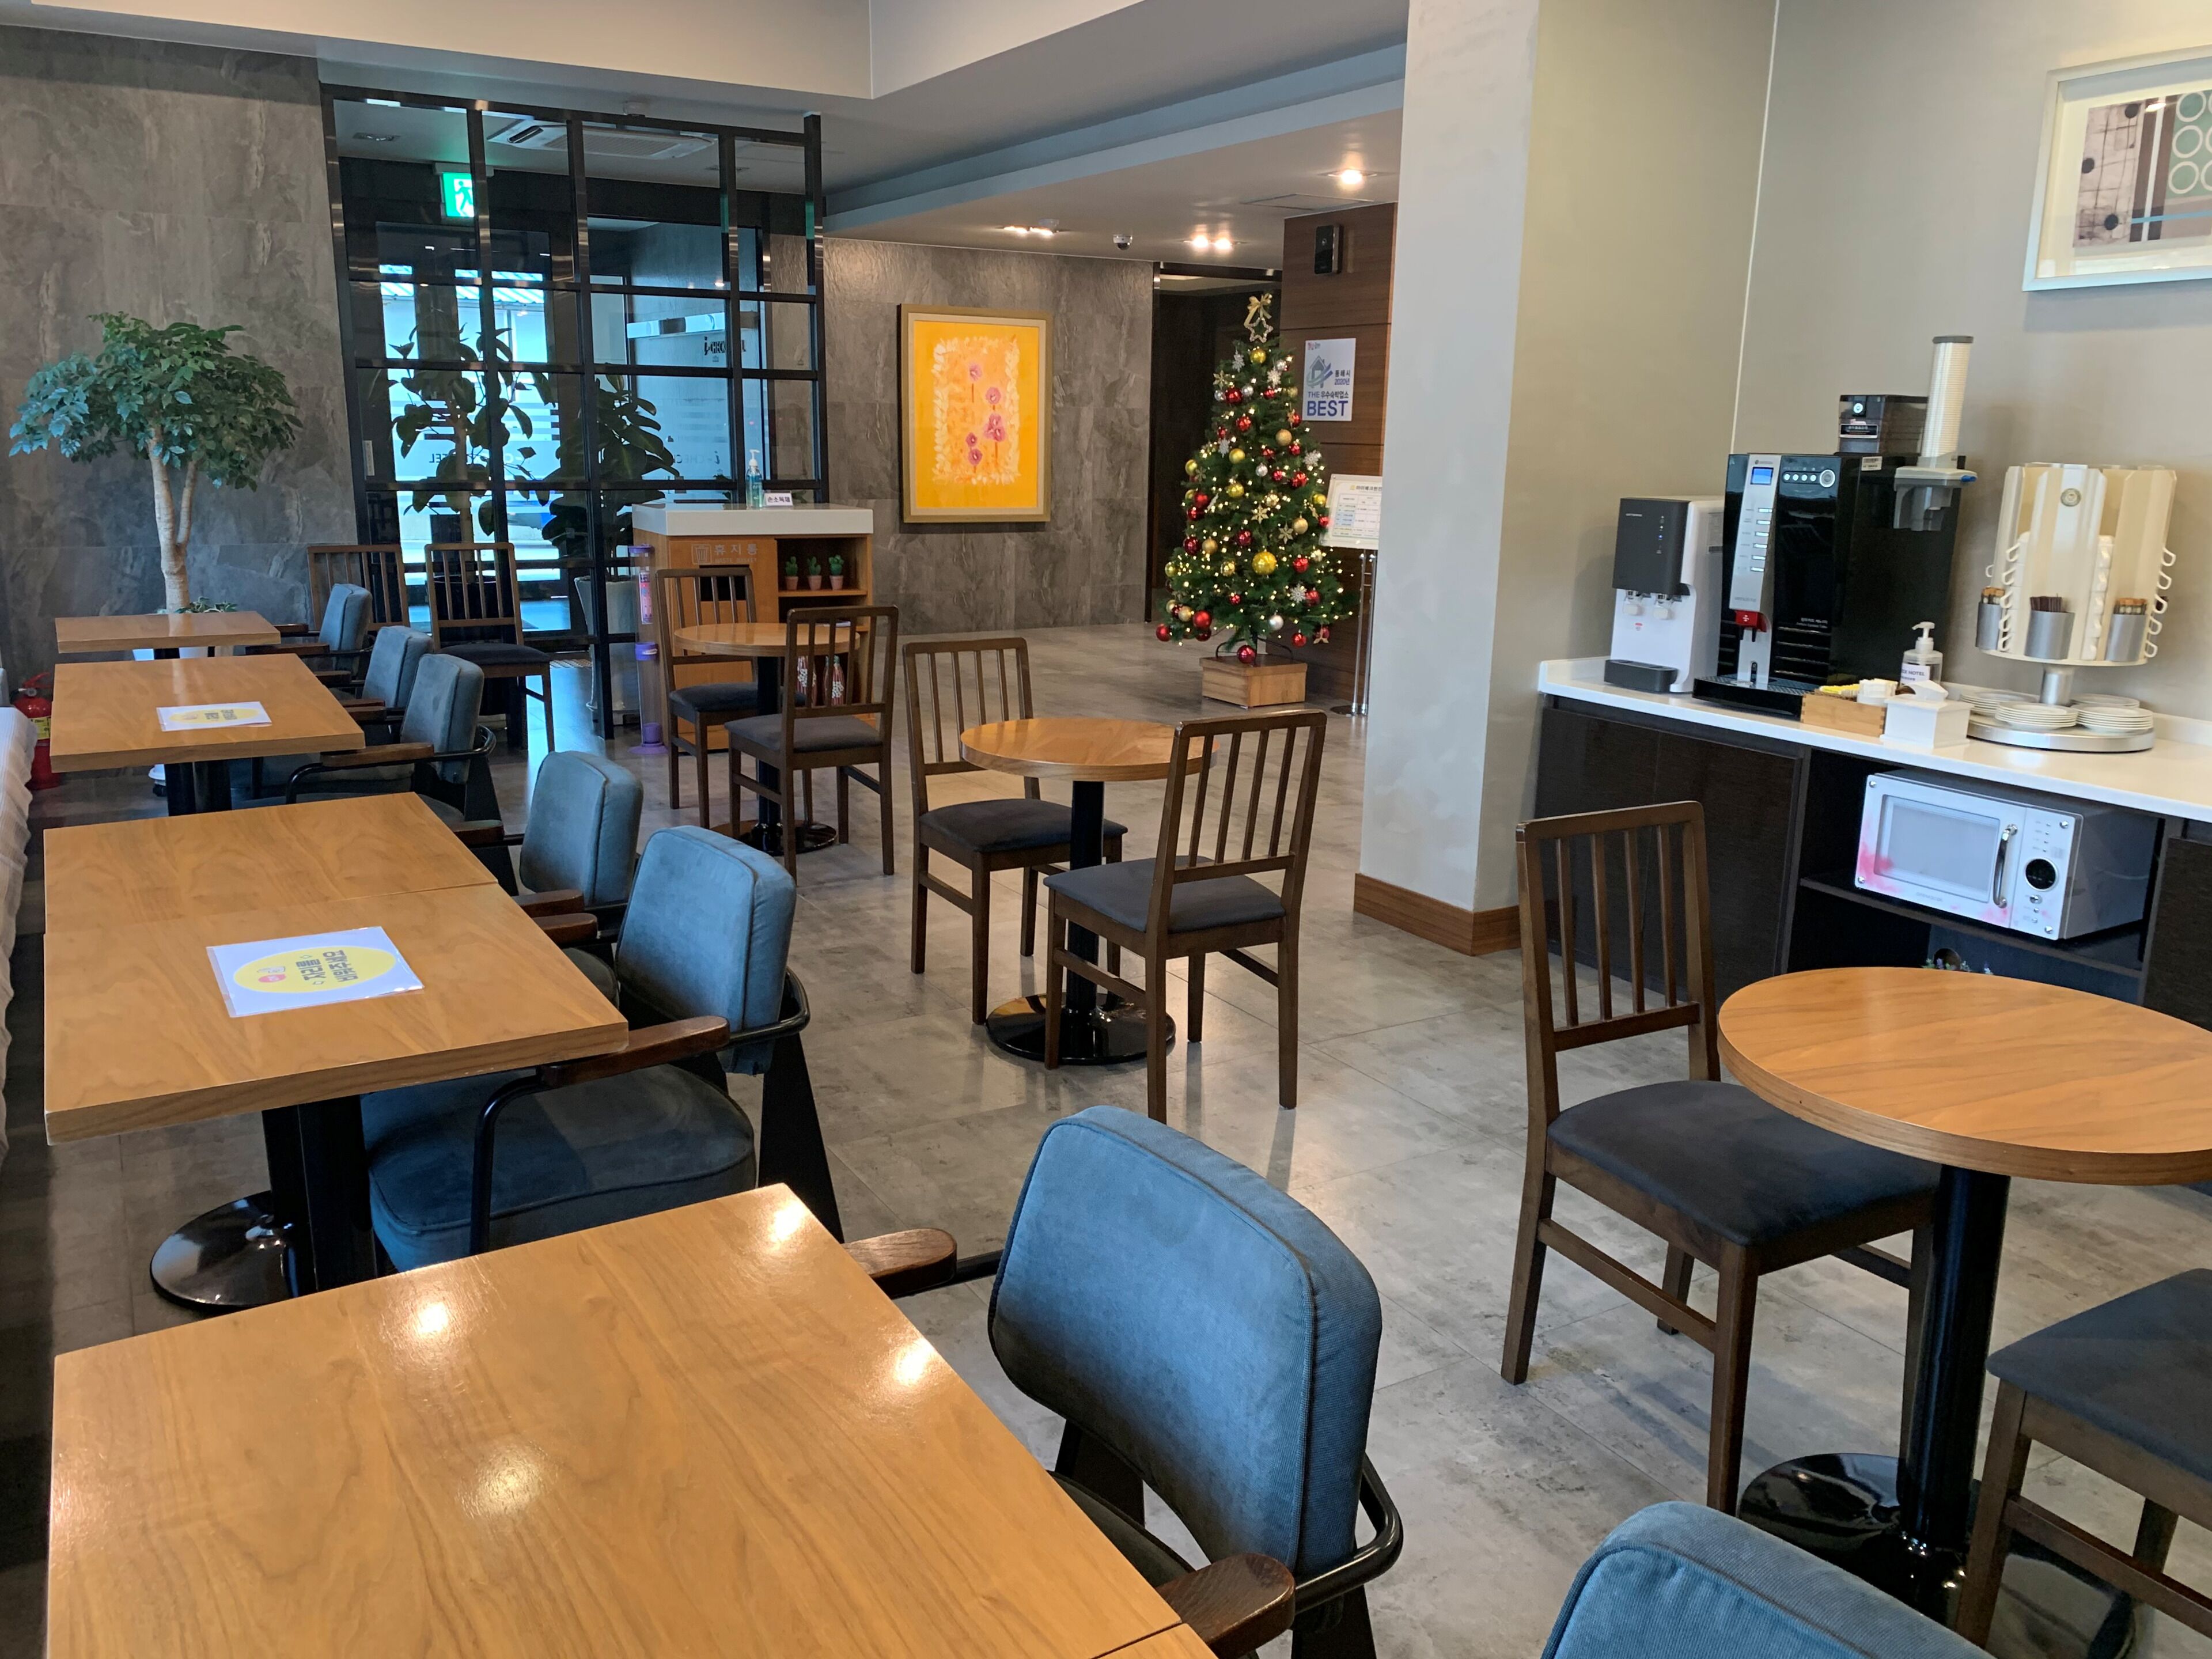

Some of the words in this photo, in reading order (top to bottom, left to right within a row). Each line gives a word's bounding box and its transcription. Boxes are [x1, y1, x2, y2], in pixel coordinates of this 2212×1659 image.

[1306, 400, 1349, 416] BEST
[714, 543, 758, 555] 휴지통
[296, 959, 327, 980] 자리를
[323, 949, 359, 983] 비워주세요
